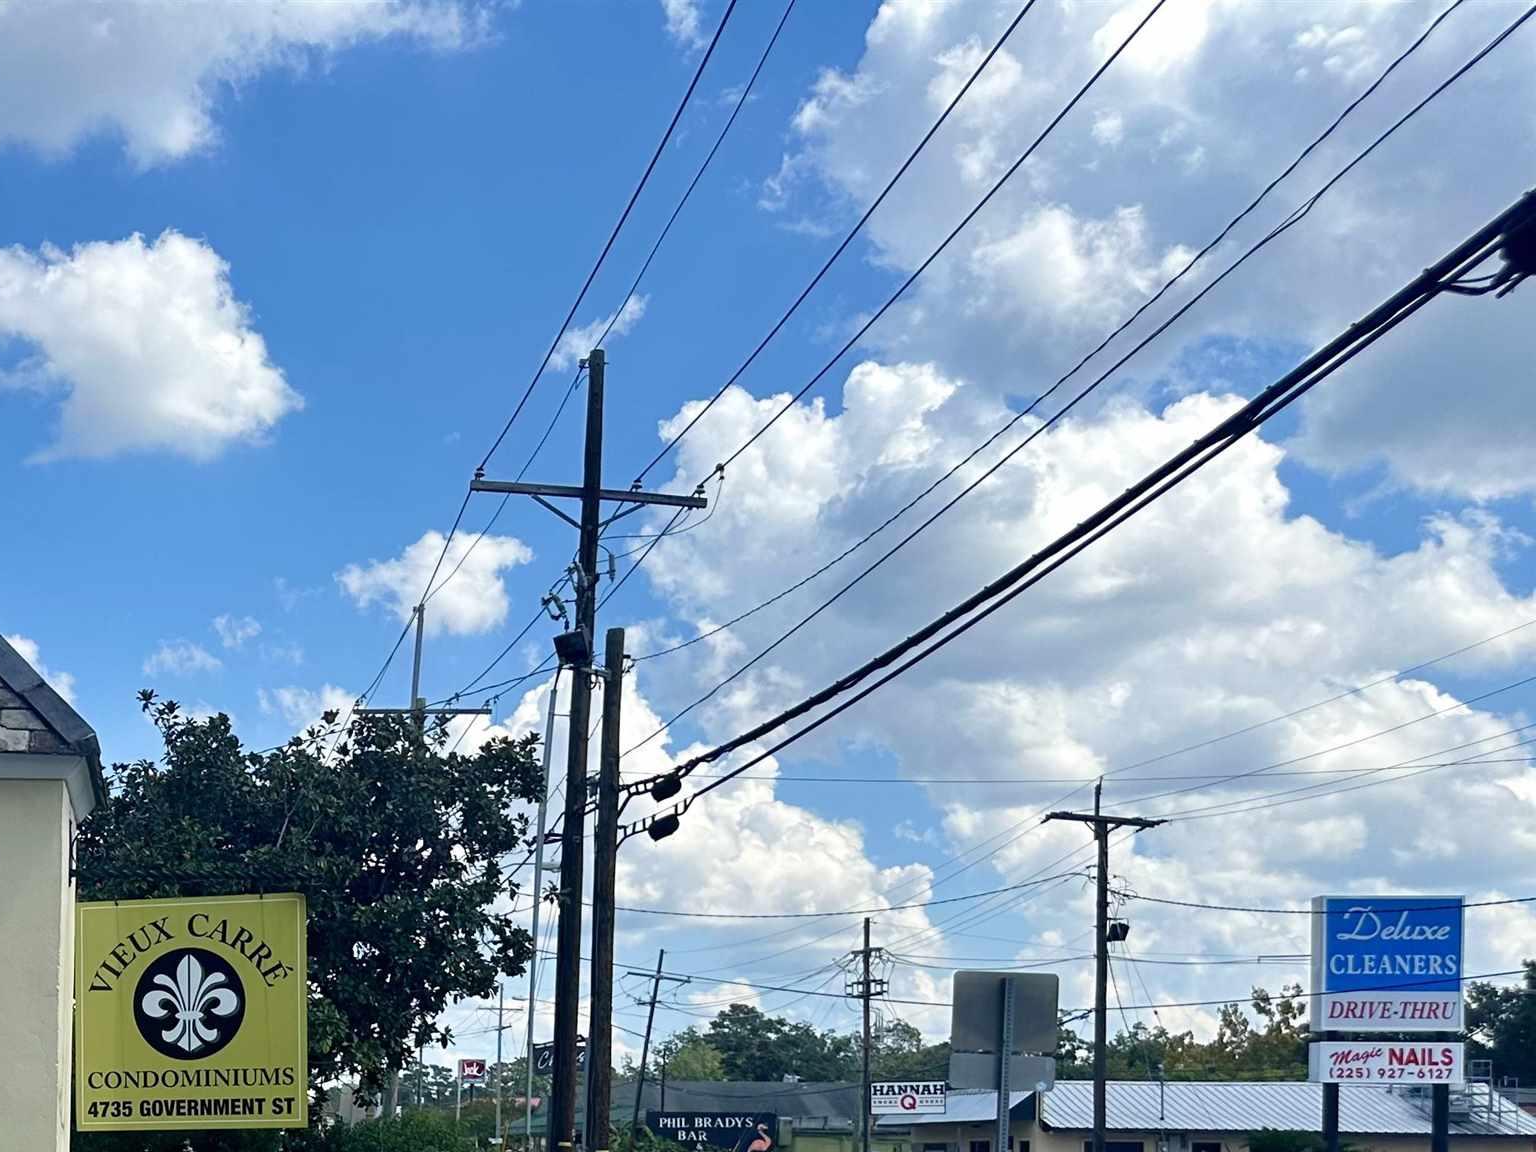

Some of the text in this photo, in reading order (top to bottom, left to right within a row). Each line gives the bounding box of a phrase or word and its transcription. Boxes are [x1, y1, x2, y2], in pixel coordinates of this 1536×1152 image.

[1336, 906, 1451, 941] Deluxe
[88, 913, 294, 994] VIEUX CARRÉ
[1329, 954, 1457, 975] CLEANERS
[1328, 1001, 1456, 1020] DRIVE-THRU
[1329, 1047, 1453, 1066] Magic NAILS
[88, 1067, 294, 1089] CONDOMINIUMS
[1329, 1067, 1453, 1079] (225) 927-6127
[872, 1084, 944, 1095] HANNAH
[88, 1098, 295, 1117] 4735 GOVERNMENT ST
[901, 1095, 916, 1110] Q
[659, 1117, 689, 1128] PHIL
[678, 1130, 707, 1141] BAR
